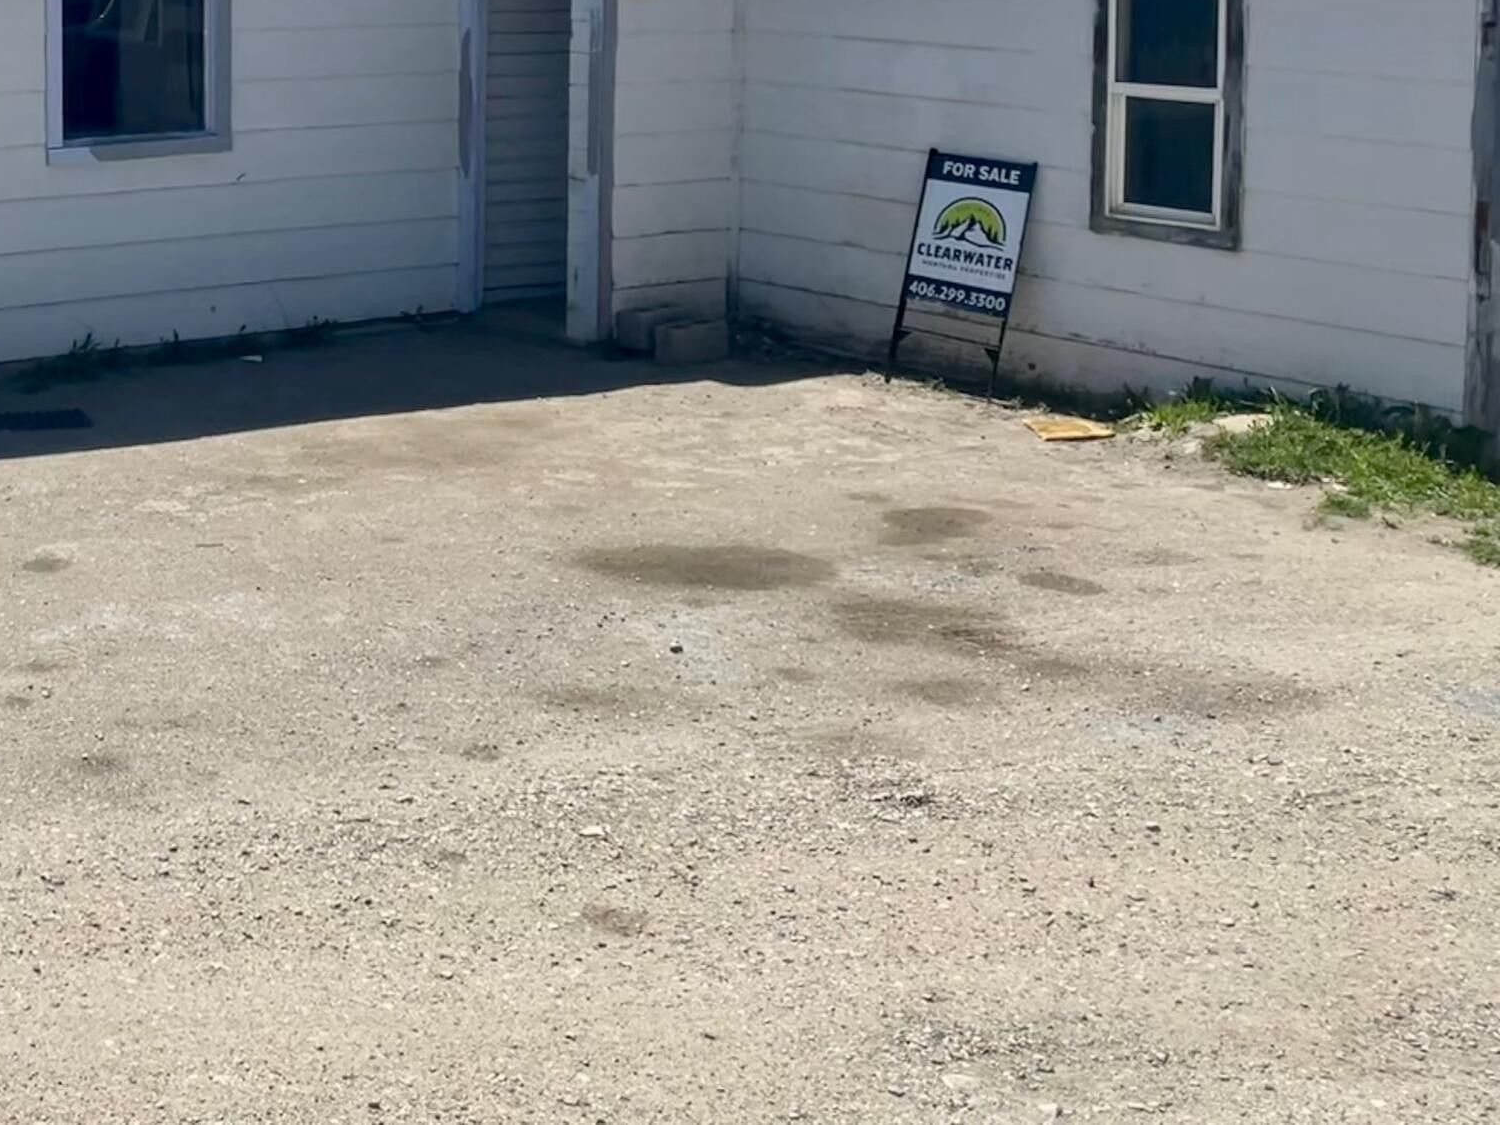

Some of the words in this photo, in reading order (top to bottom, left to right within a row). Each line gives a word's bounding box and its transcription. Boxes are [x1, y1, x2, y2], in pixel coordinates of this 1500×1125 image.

[942, 160, 976, 179] FOR
[978, 165, 1021, 185] SALE
[917, 243, 1013, 271] CLEARWATER
[909, 280, 1006, 311] 406.299.3300
